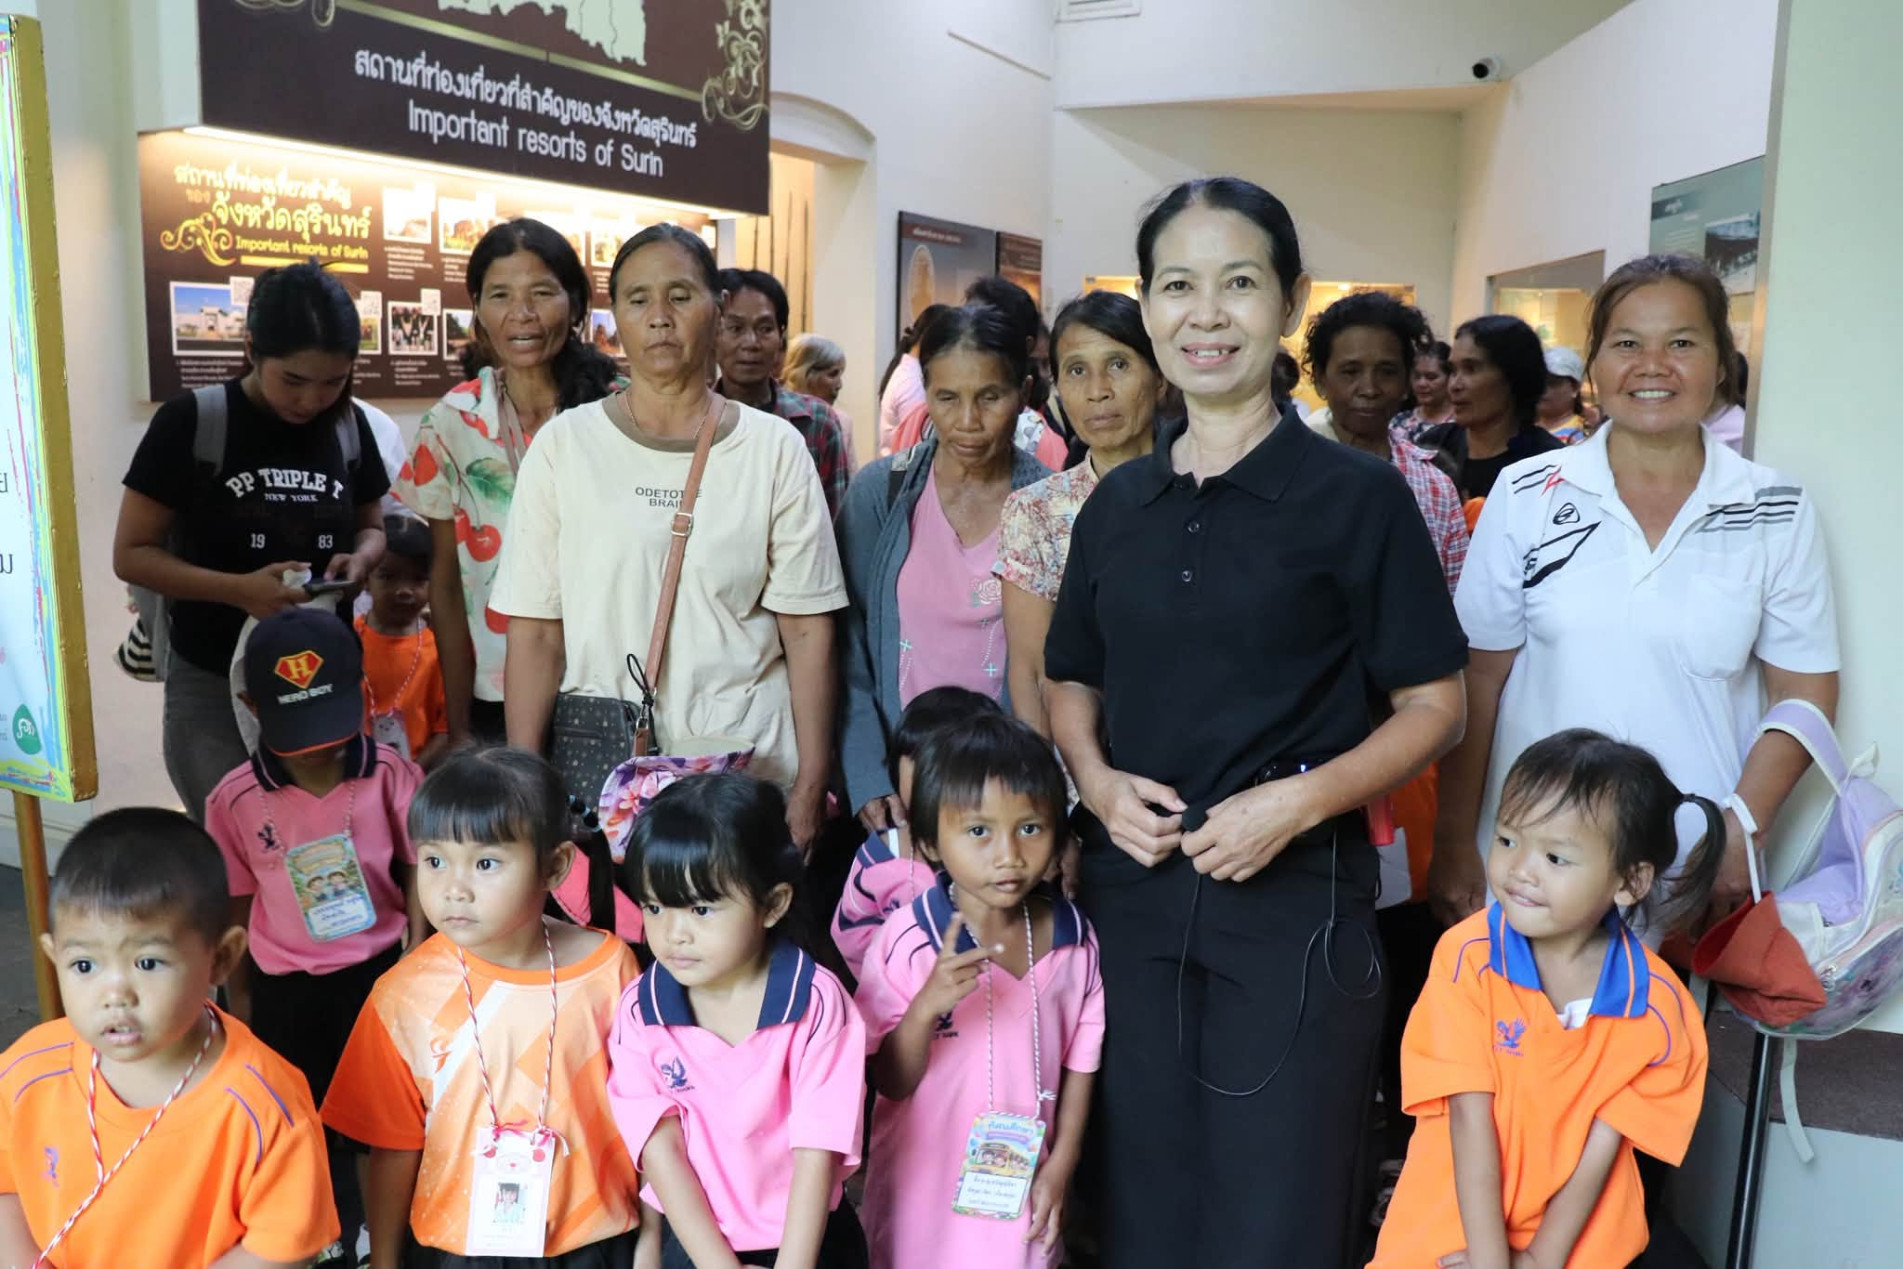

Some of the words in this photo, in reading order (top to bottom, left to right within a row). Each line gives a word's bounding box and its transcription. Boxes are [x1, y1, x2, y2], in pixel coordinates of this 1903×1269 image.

[409, 98, 509, 148] Important
[517, 127, 587, 163] resorts
[595, 138, 614, 167] of
[621, 143, 663, 178] Surin
[212, 191, 371, 243] จังหวัดสุรินทร์
[236, 235, 290, 253] Important
[342, 244, 369, 260] Surin
[226, 472, 255, 498] PP
[258, 468, 327, 492] TRIPLE
[265, 493, 286, 501] NEW
[251, 533, 265, 549] 19
[318, 535, 333, 549] 83
[277, 691, 308, 704] HERO
[308, 683, 334, 698] BOY
